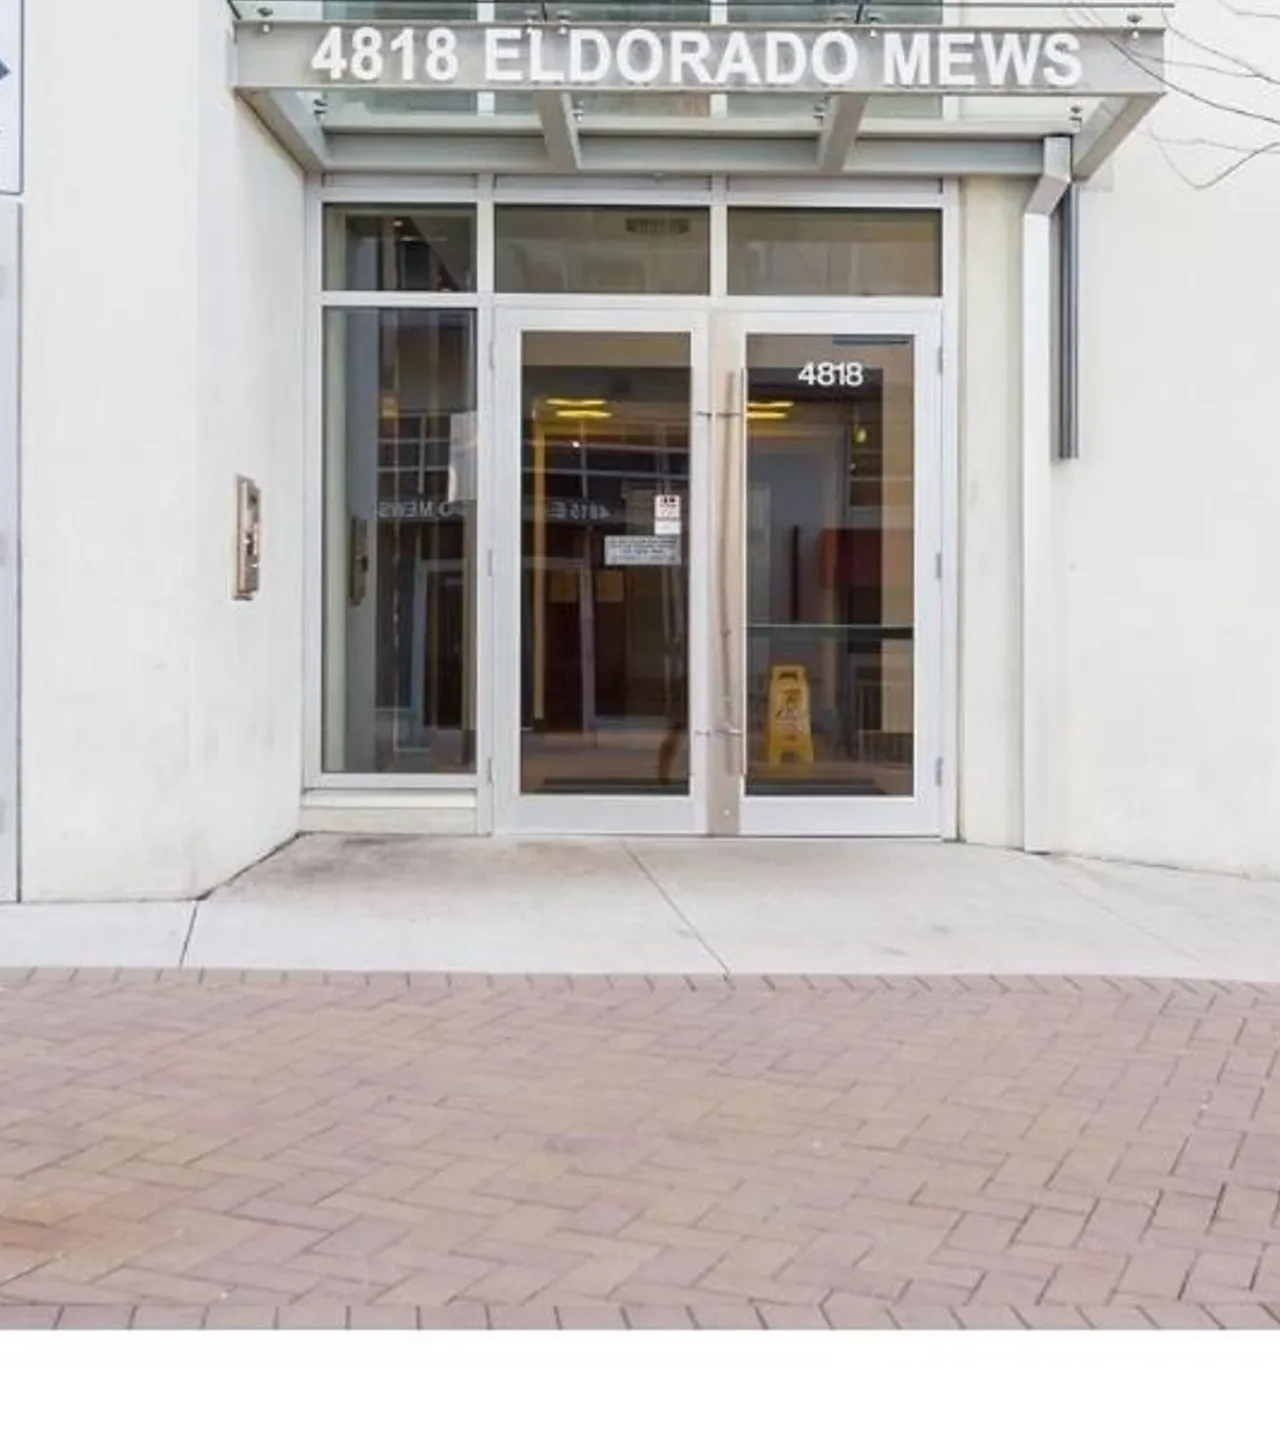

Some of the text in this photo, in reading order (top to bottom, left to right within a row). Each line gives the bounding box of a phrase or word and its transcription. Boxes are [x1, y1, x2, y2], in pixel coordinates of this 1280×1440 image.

[311, 26, 1083, 87] 4818 ELDORADO MEWS
[798, 361, 864, 387] 4818
